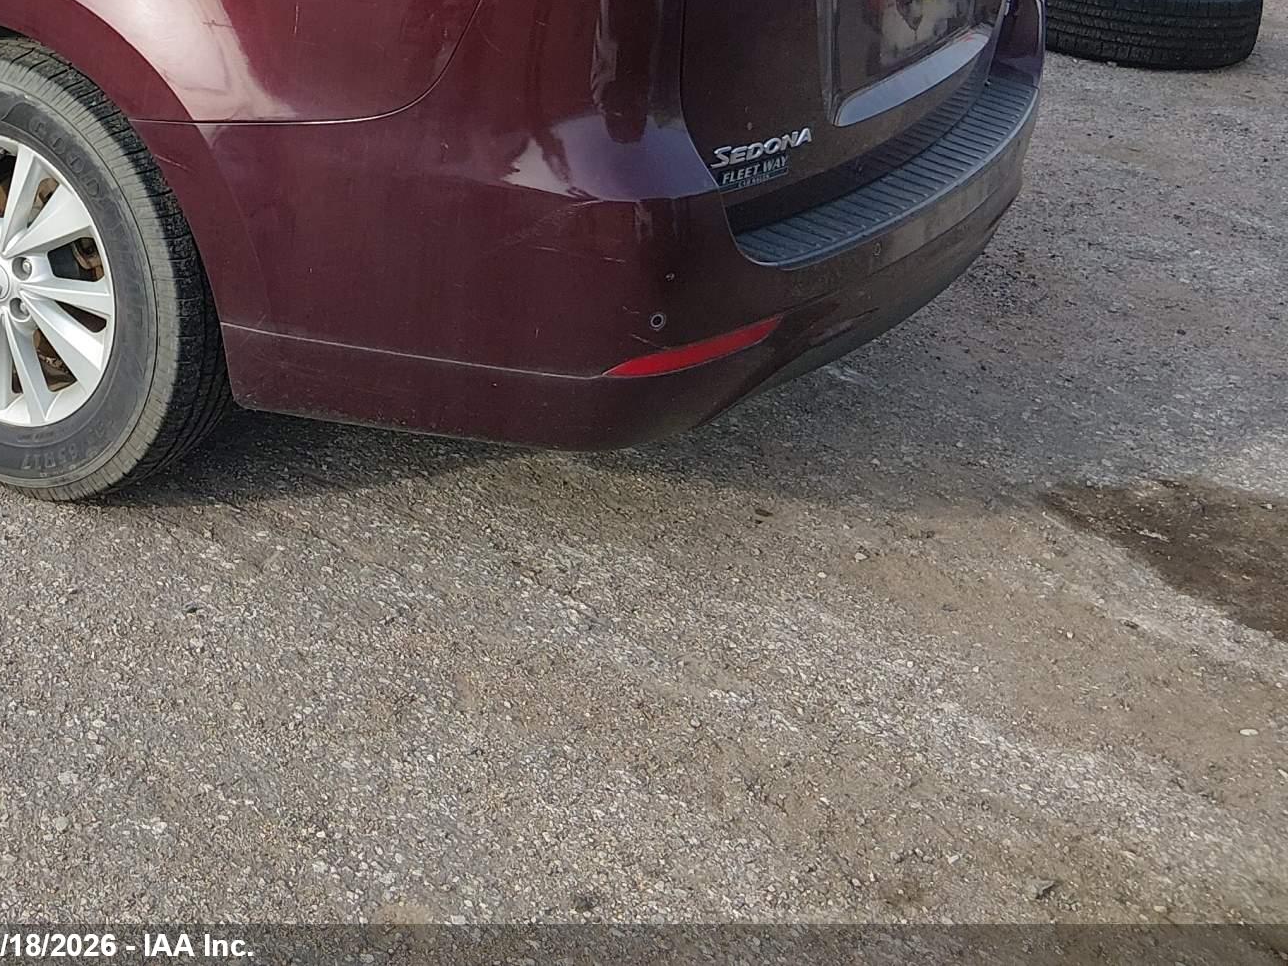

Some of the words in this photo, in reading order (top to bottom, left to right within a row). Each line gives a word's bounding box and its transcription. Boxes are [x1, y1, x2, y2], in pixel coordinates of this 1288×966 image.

[710, 127, 812, 169] SEDONA
[722, 163, 761, 185] FLEET
[762, 155, 789, 173] WAY
